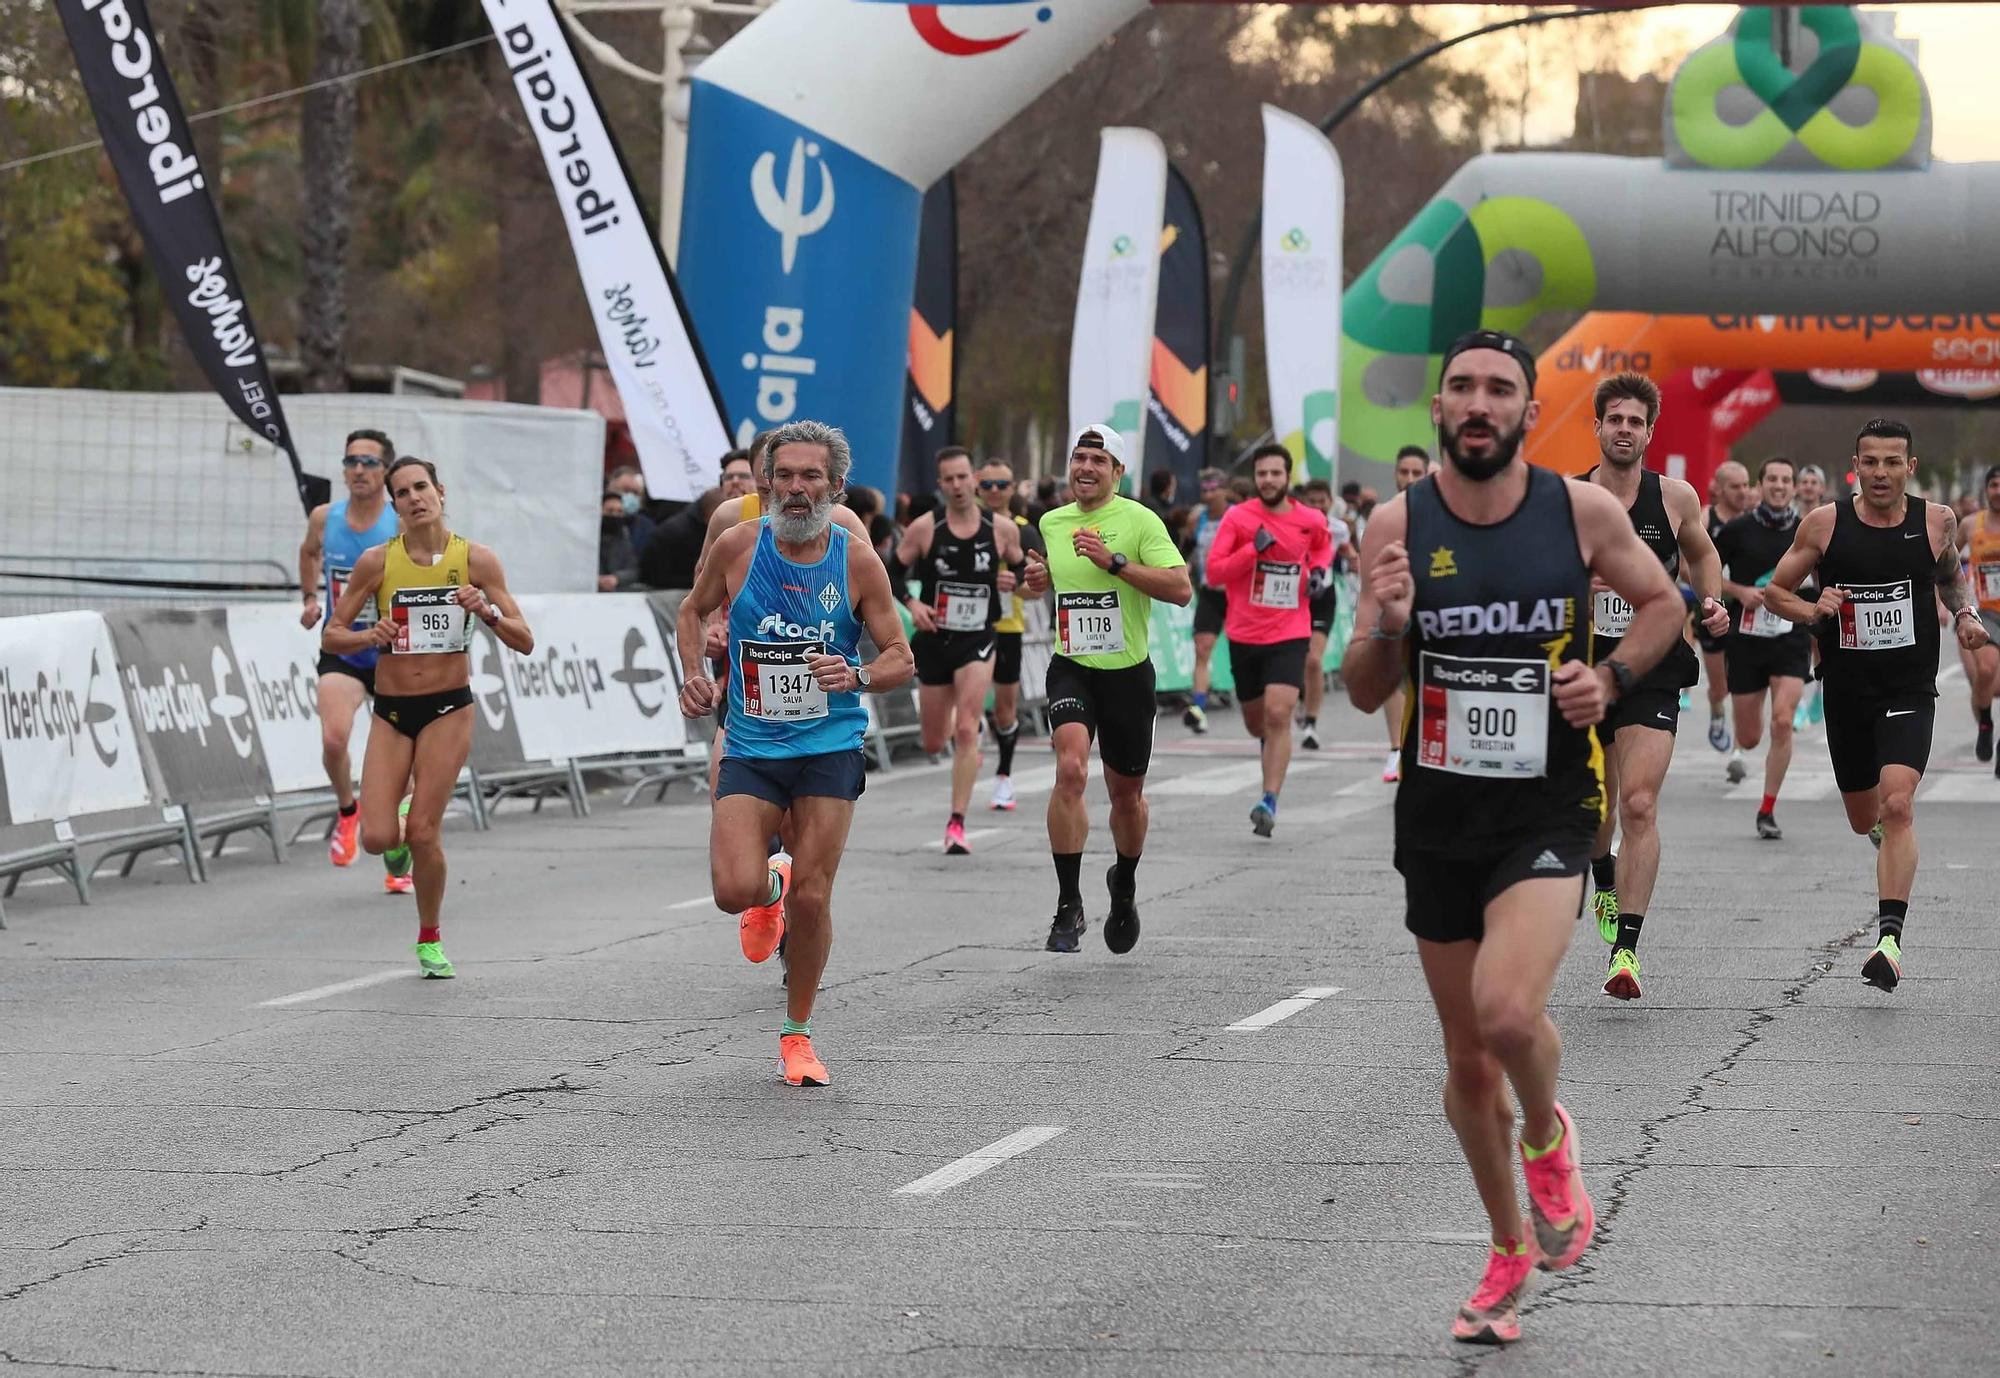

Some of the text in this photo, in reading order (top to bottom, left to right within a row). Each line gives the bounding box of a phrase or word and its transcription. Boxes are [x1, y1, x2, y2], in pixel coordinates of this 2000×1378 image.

[1709, 190, 1881, 223] TRINIDAD
[1710, 226, 1880, 258] ALFONSO
[1555, 341, 1652, 373] divina
[398, 594, 438, 603] iberCaja
[1062, 597, 1094, 606] iberCaja
[1603, 596, 1635, 614] 104
[422, 613, 450, 630] 963
[1077, 617, 1112, 633] 1178
[1416, 597, 1566, 641] REDOLAT
[1864, 608, 1902, 627] 1040
[1881, 627, 1900, 635] MORAL
[749, 648, 792, 662] iberCaja
[506, 643, 605, 710] iberCaja
[769, 674, 813, 694] 1347
[1432, 664, 1498, 687] iberCaja
[246, 656, 321, 721] iberCa
[782, 696, 803, 704] SALVA
[1468, 707, 1516, 737] 900
